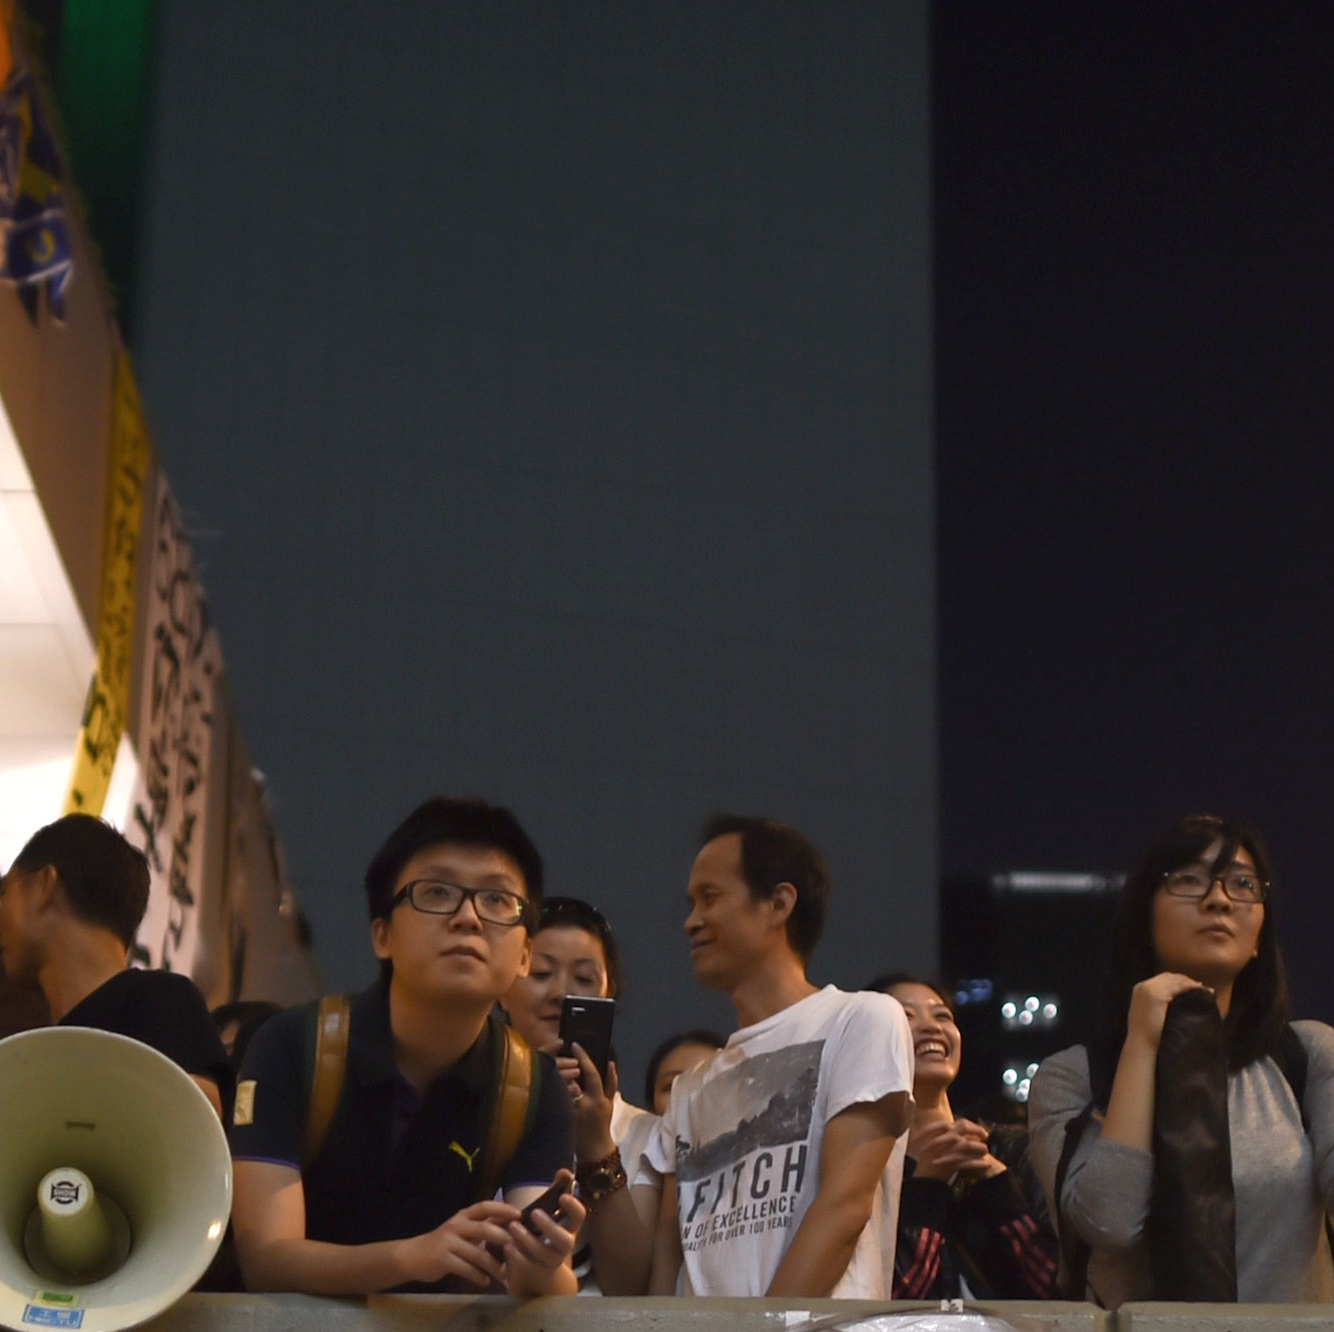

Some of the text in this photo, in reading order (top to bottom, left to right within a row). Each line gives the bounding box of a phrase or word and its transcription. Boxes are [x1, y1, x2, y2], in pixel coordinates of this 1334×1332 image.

[687, 1145, 809, 1222] FITCH
[695, 1221, 709, 1239] OF
[712, 1195, 797, 1229] EXCELLENCE
[708, 1232, 723, 1246] FOR
[725, 1226, 745, 1240] OVER
[749, 1220, 764, 1235] 100
